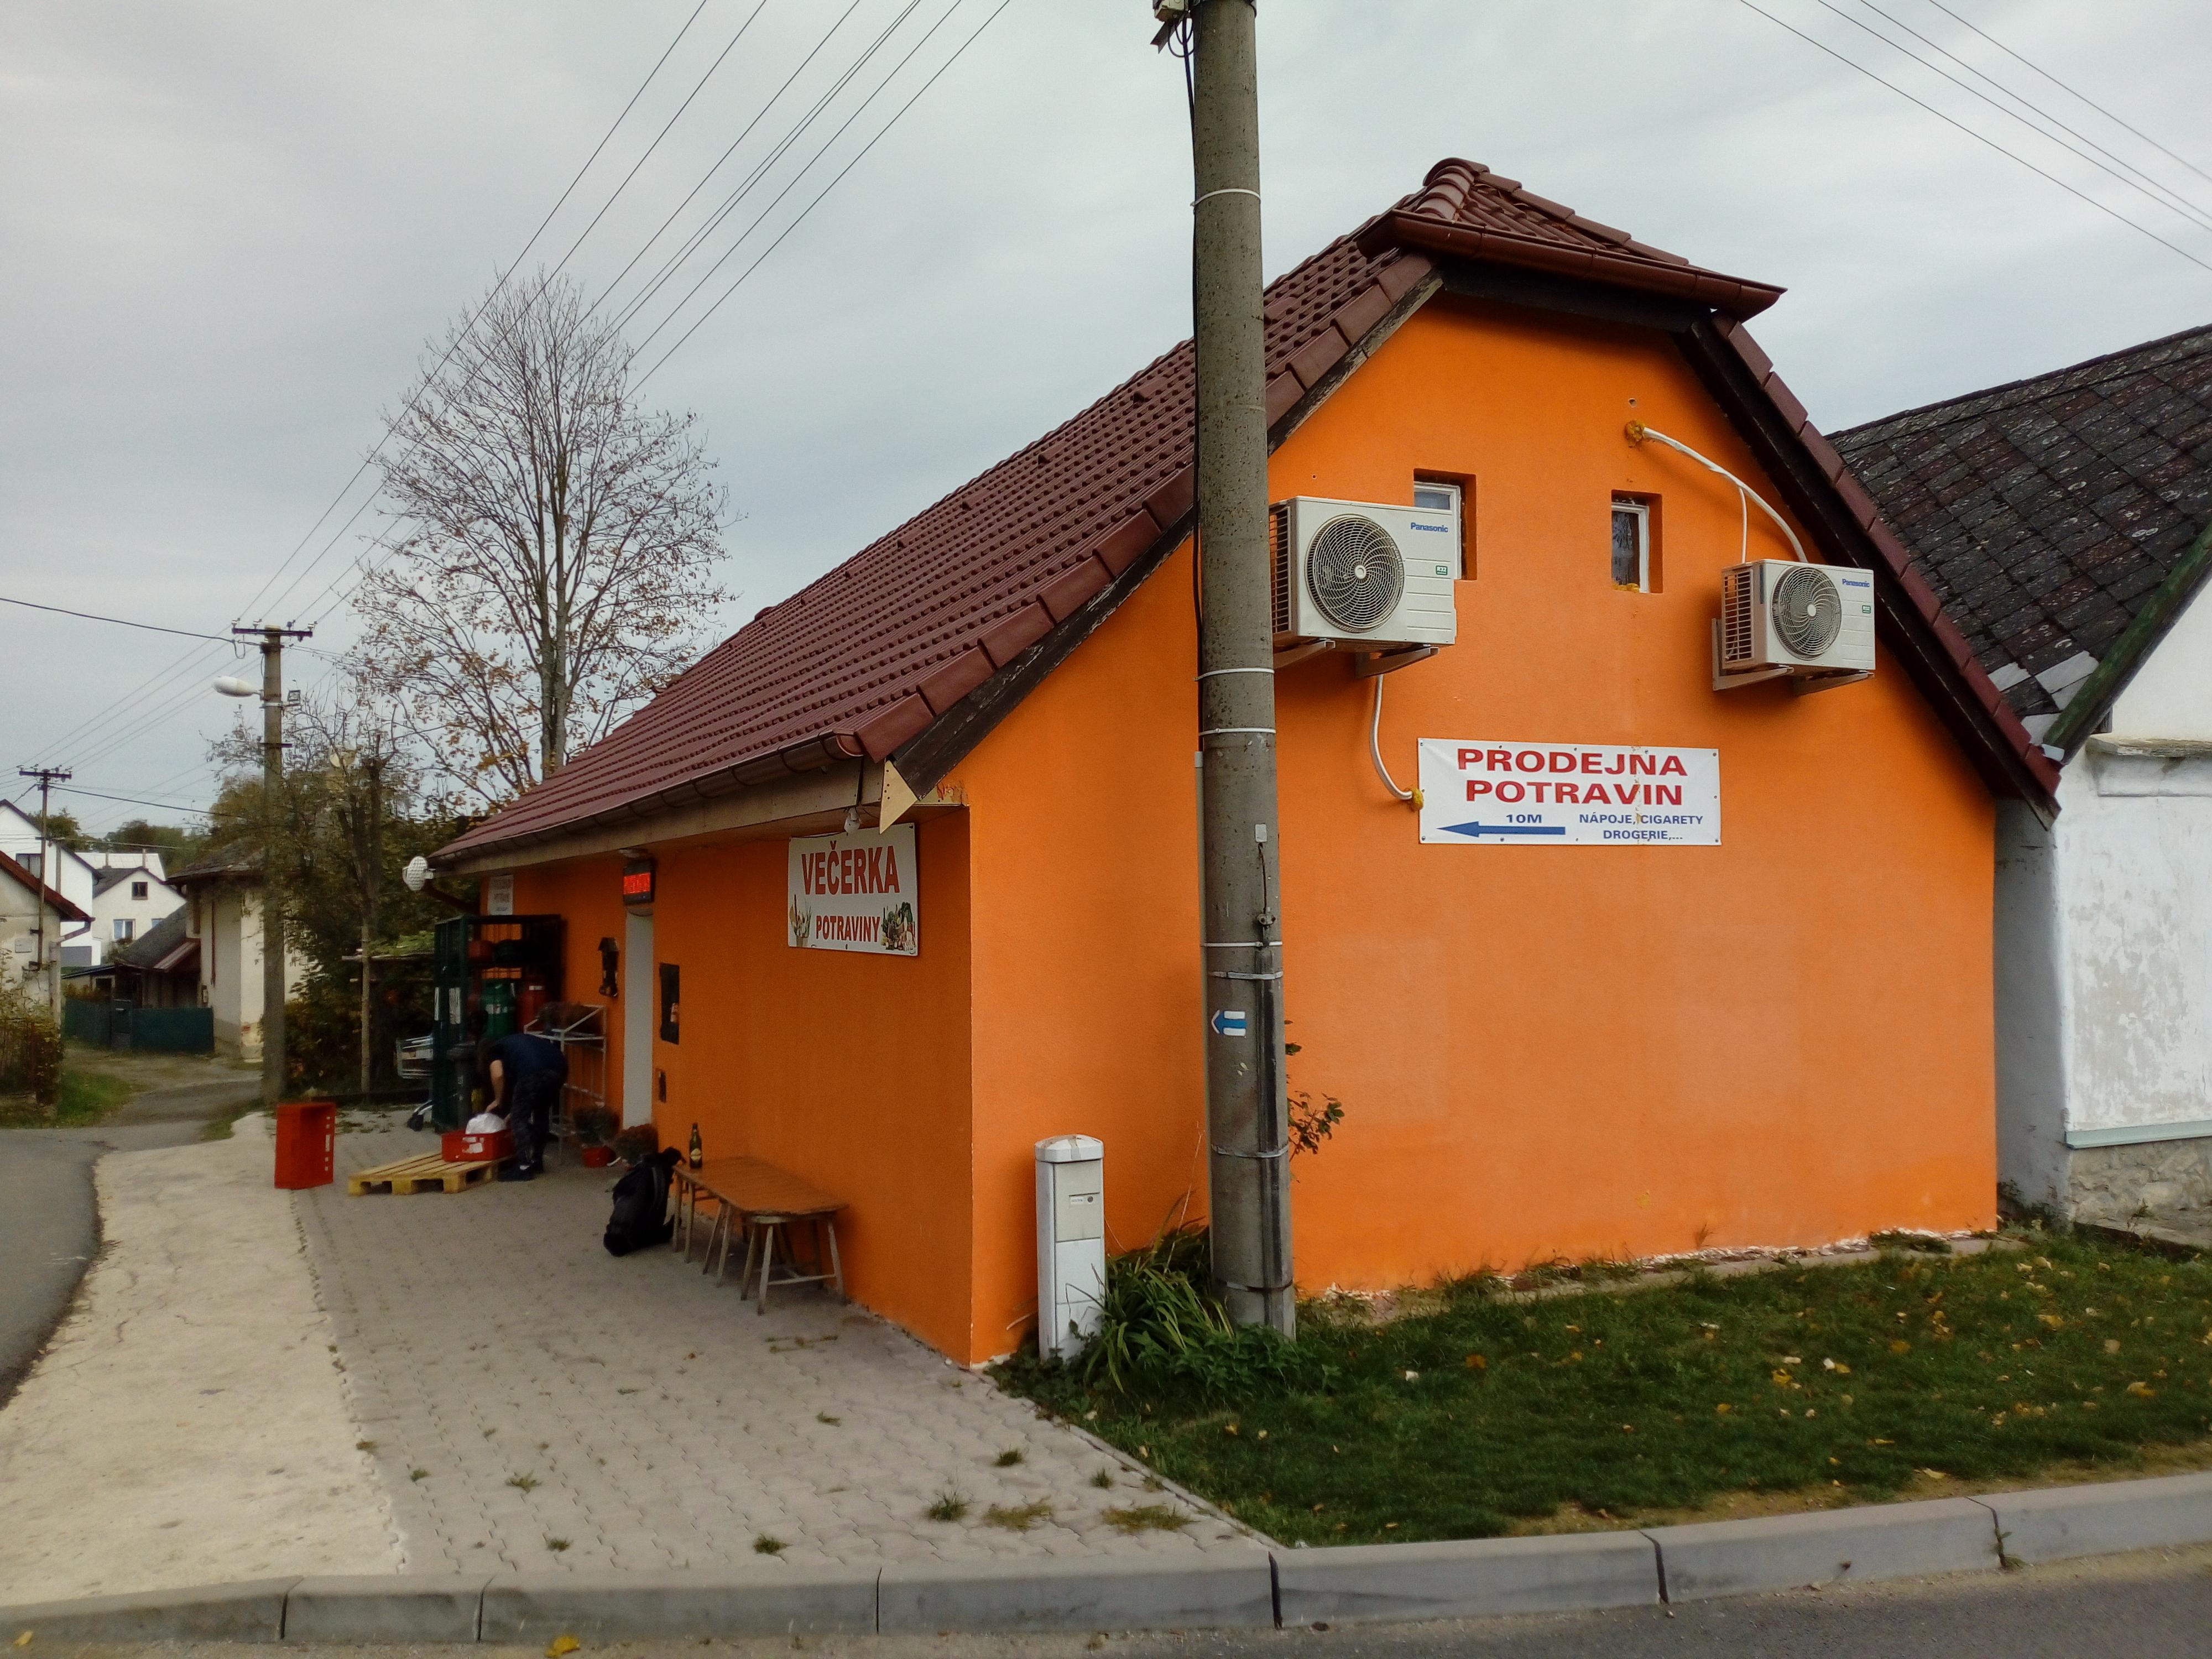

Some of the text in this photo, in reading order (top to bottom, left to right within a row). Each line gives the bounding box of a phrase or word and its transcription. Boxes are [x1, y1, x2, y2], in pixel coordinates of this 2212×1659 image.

[1410, 522, 1448, 533] Panasonic
[1457, 748, 1688, 776] PRODEJNA
[1465, 780, 1682, 805] POTRAVIN
[1506, 814, 1542, 823] 10M
[1579, 812, 1703, 825] NÁPOJE, CIGARETY
[801, 840, 900, 895] VEČERKA
[816, 915, 880, 942] POTRAVINY
